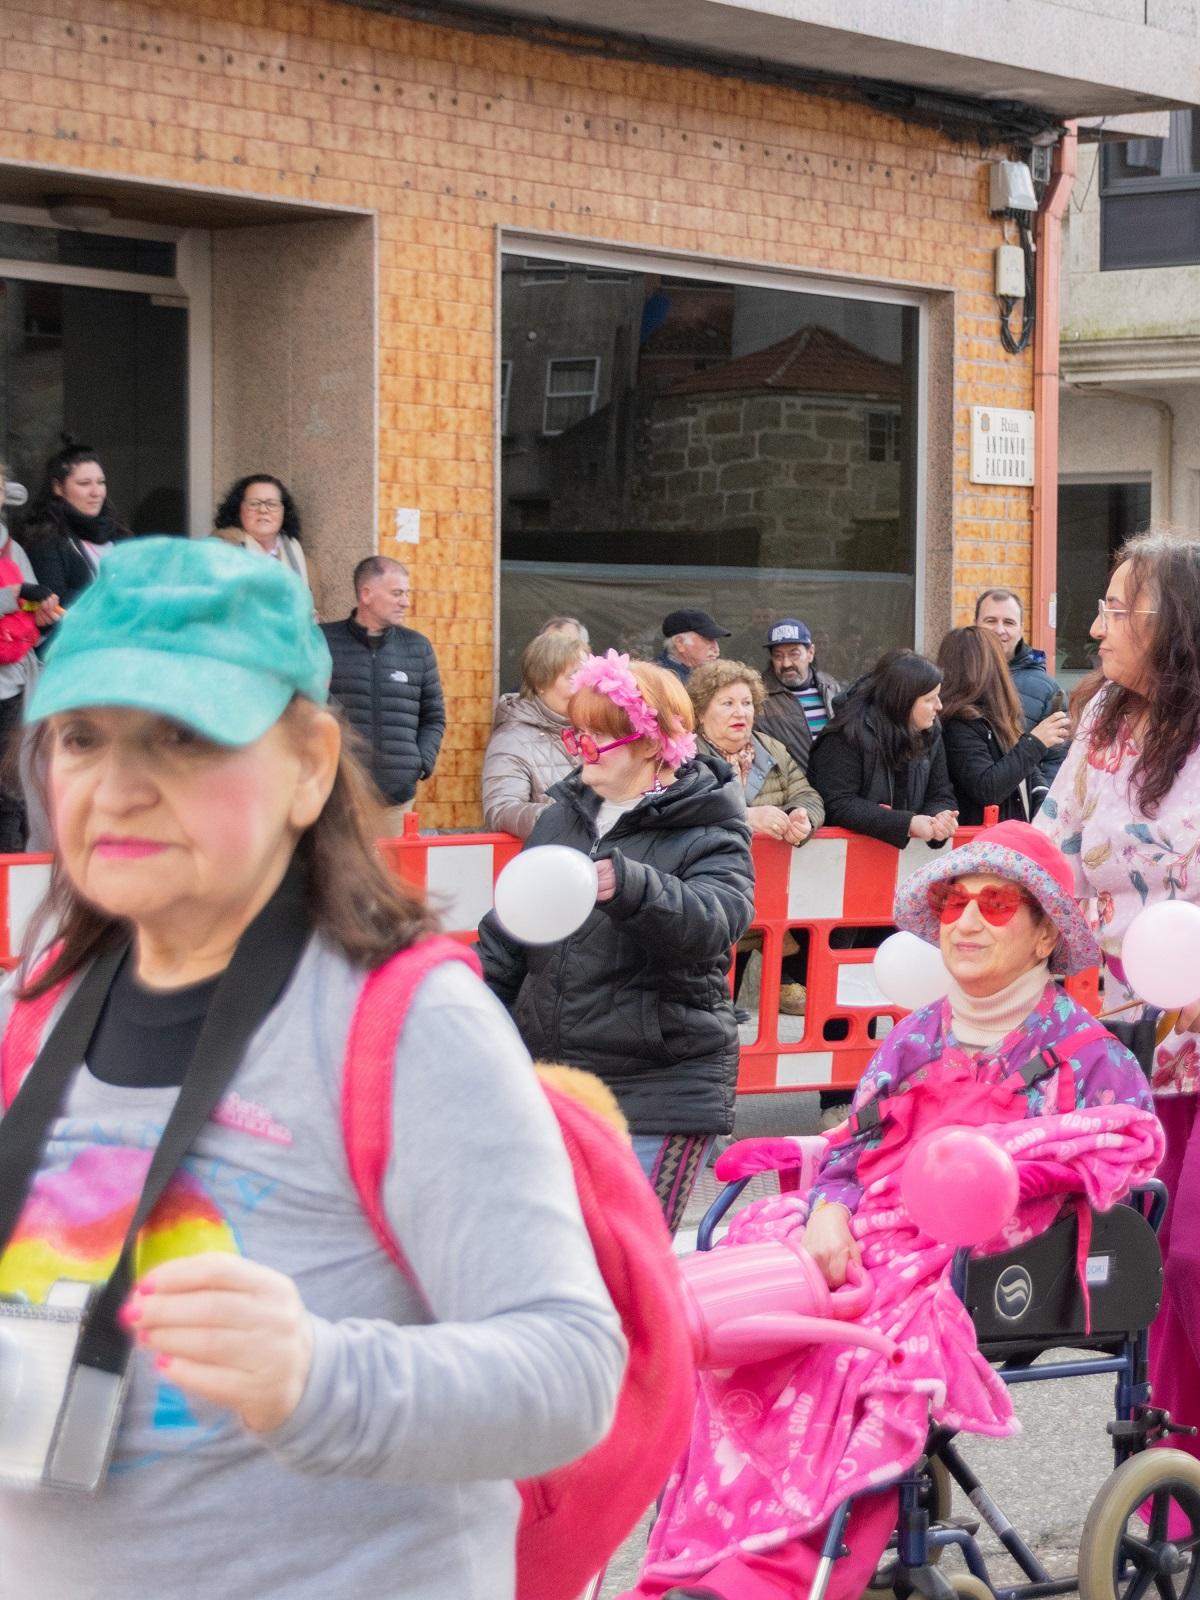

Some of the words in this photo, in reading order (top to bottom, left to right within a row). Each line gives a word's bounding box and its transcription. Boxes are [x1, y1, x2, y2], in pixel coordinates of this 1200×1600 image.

[986, 436, 1024, 455] ANTONIO
[985, 457, 1025, 477] FACORRO
[788, 1393, 814, 1436] GOOD
